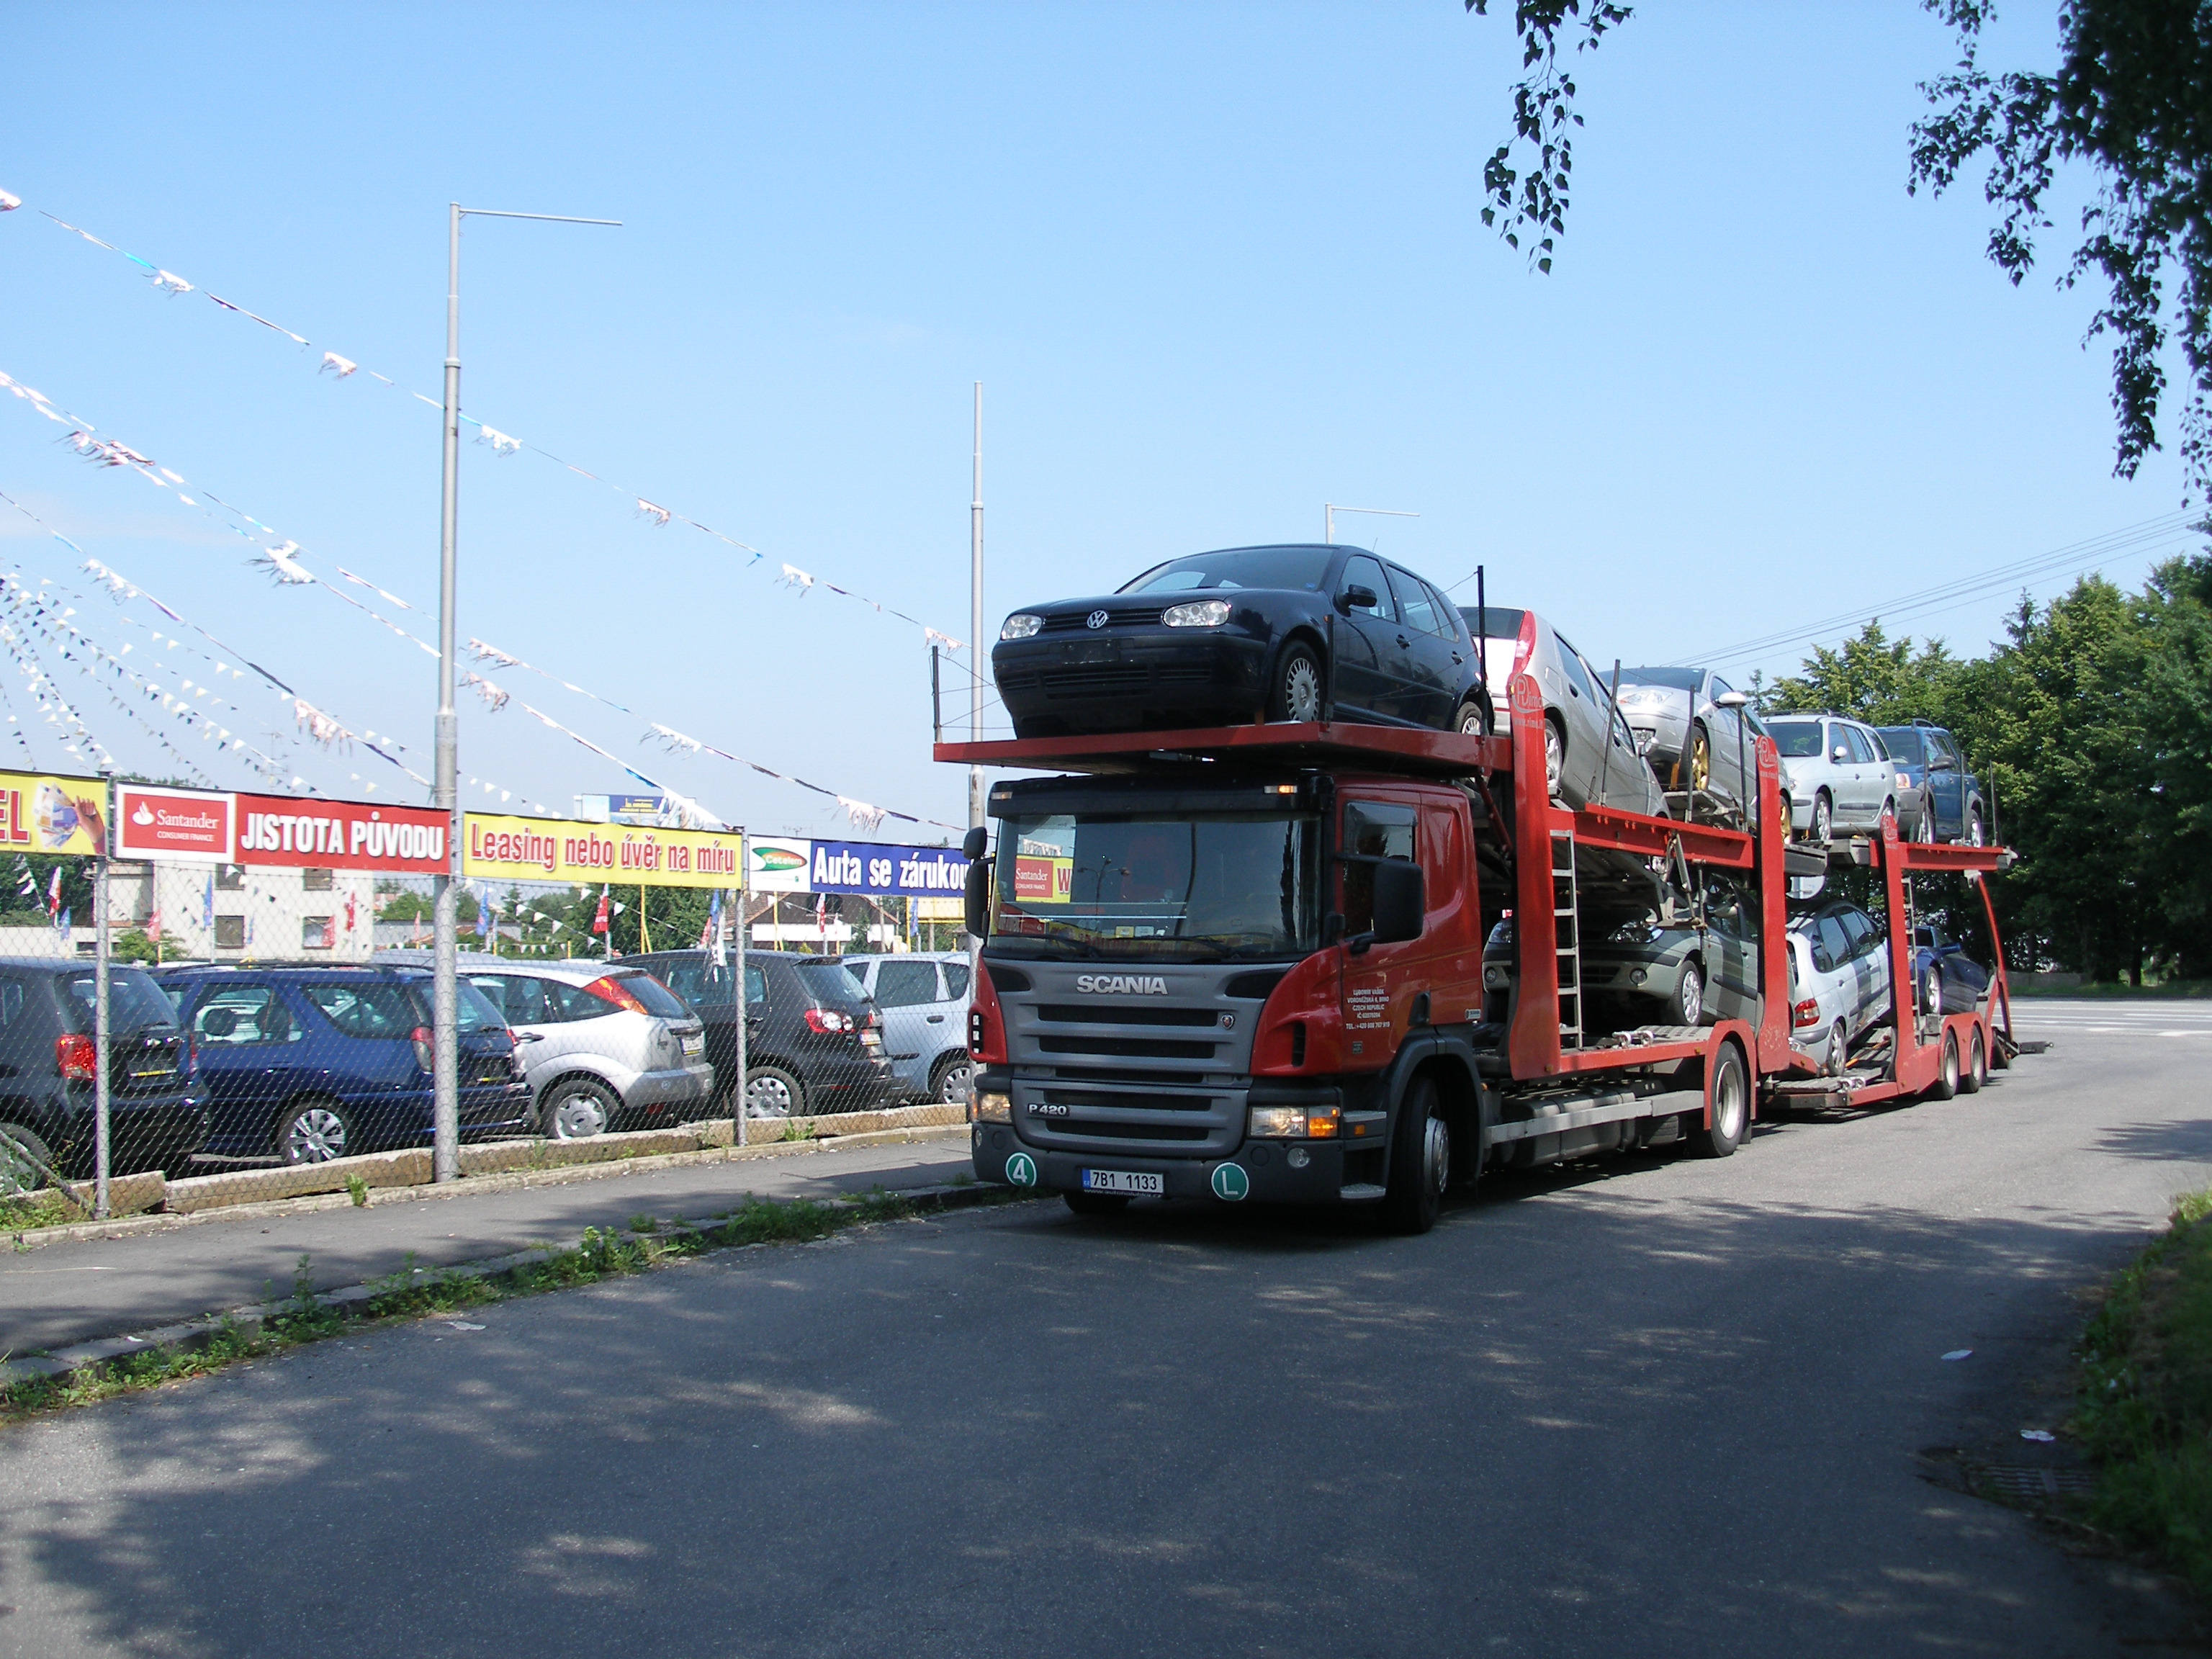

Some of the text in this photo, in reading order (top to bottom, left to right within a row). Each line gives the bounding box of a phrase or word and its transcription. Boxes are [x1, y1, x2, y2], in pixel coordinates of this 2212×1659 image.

[157, 809, 220, 829] Santander
[157, 830, 214, 842] CONSUMER FINANCE
[241, 811, 444, 860] JISTOTA PŮVODU
[471, 823, 735, 873] Leasing nebo úvěr na míru
[765, 855, 803, 866] Cetelem
[813, 847, 861, 886] Auta
[869, 858, 892, 887] se
[1015, 868, 1048, 881] Santander
[1076, 975, 1168, 994] SCANIA
[1029, 1104, 1066, 1115] P 420
[1012, 1159, 1028, 1183] 4
[1093, 1172, 1156, 1190] 7B1 1133
[1222, 1170, 1238, 1195] L
